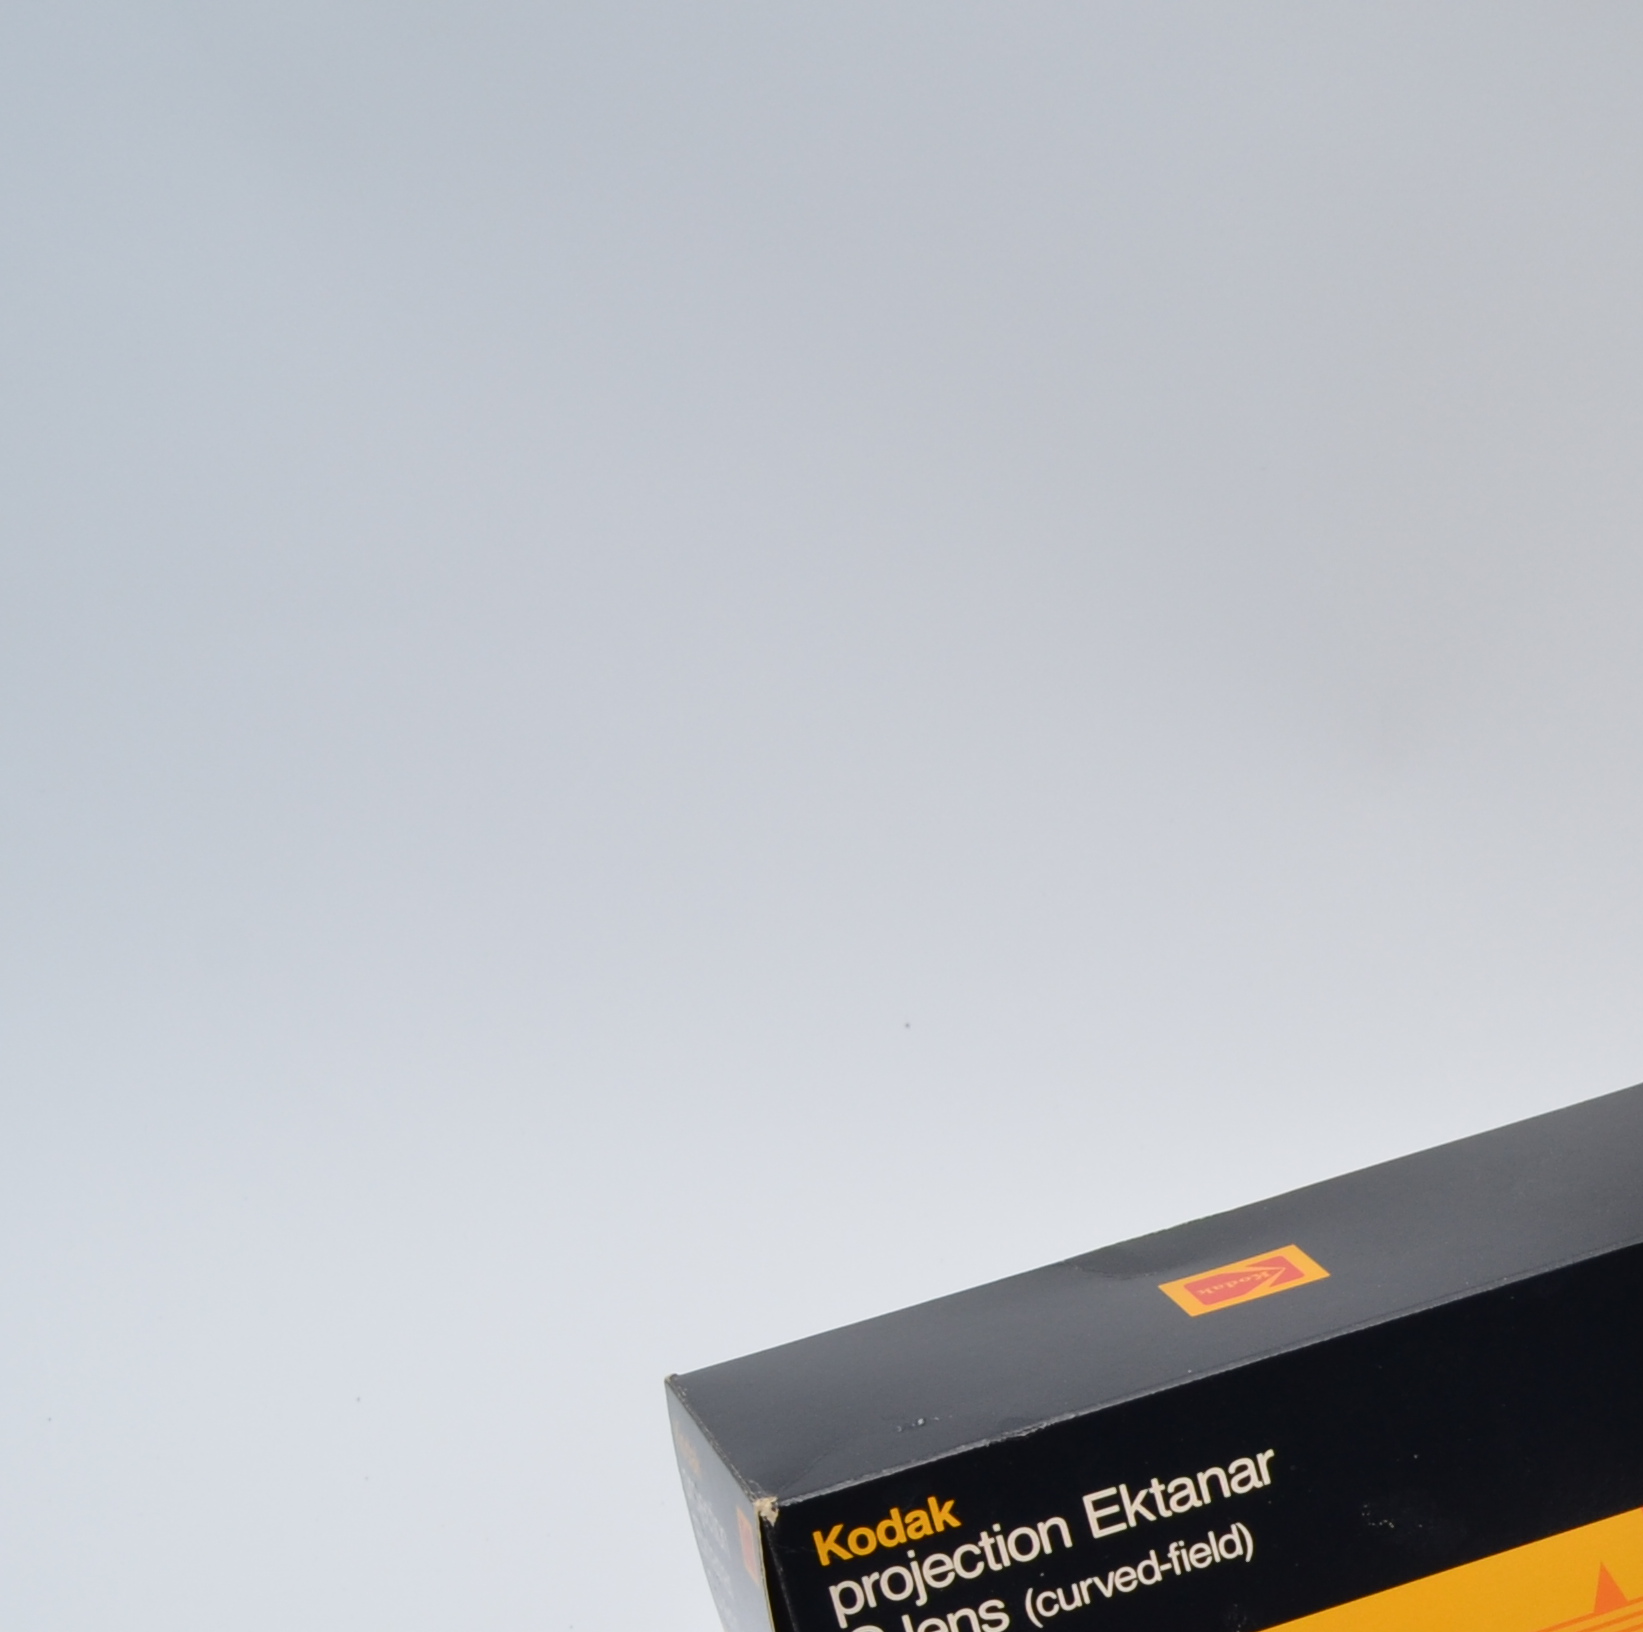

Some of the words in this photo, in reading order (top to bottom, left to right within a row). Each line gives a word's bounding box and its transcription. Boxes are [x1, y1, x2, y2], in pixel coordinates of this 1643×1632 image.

[1197, 1271, 1272, 1295] Kodak
[812, 1495, 962, 1567] Kodak
[828, 1515, 1072, 1629] projection
[1082, 1448, 1275, 1539] Ektanar
[1025, 1522, 1255, 1628] (curved-field)
